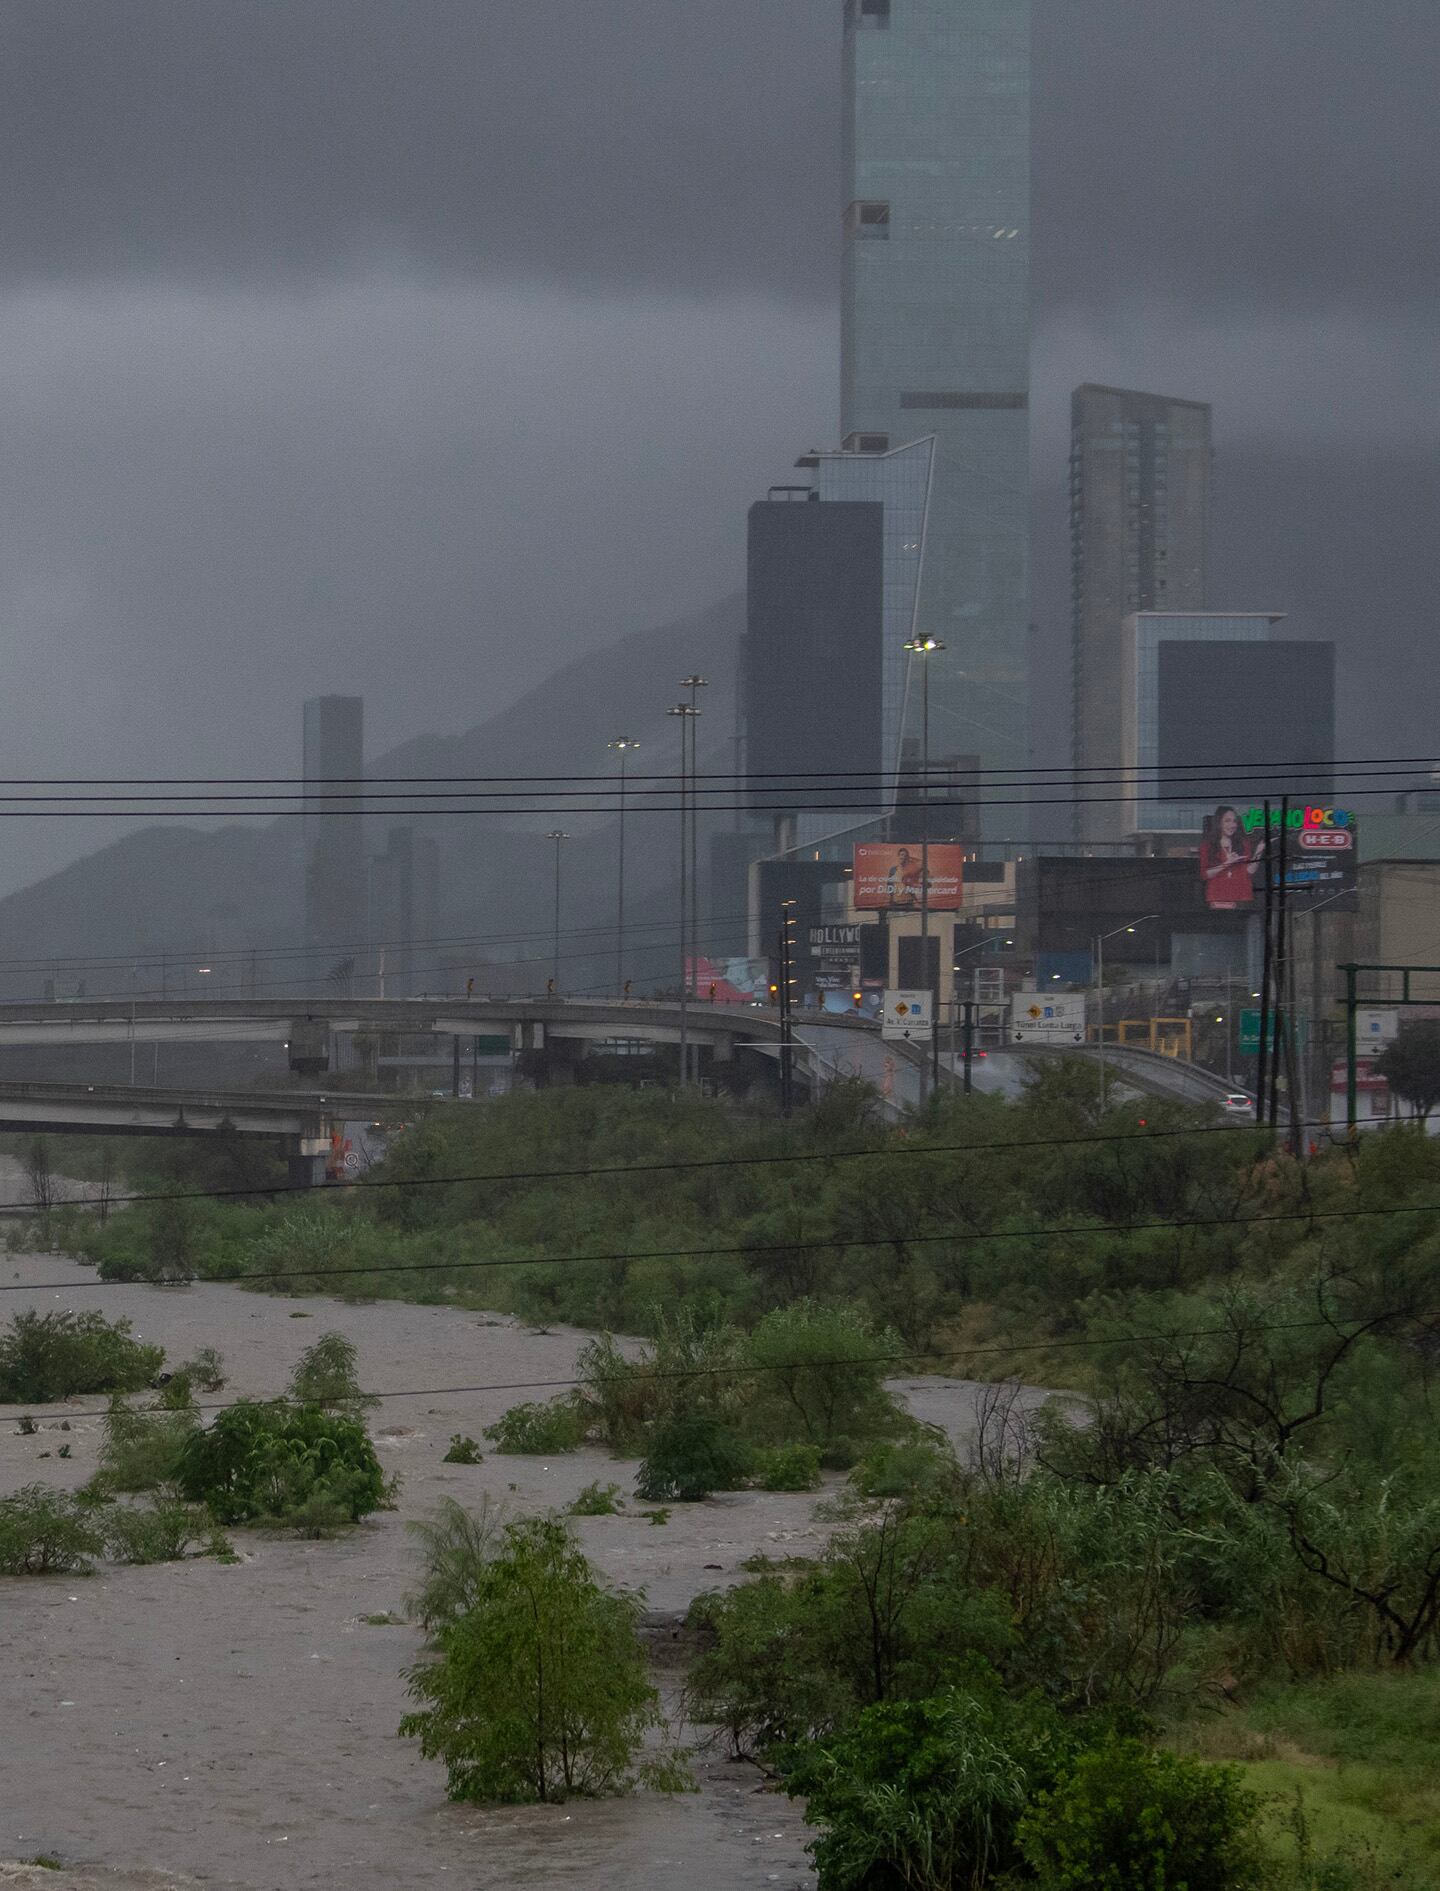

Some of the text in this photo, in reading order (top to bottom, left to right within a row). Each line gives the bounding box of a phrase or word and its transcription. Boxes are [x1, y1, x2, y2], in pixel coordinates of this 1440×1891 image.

[1241, 806, 1348, 833] VEANO LOCO
[859, 886, 875, 895] por
[877, 885, 896, 894] DiDi
